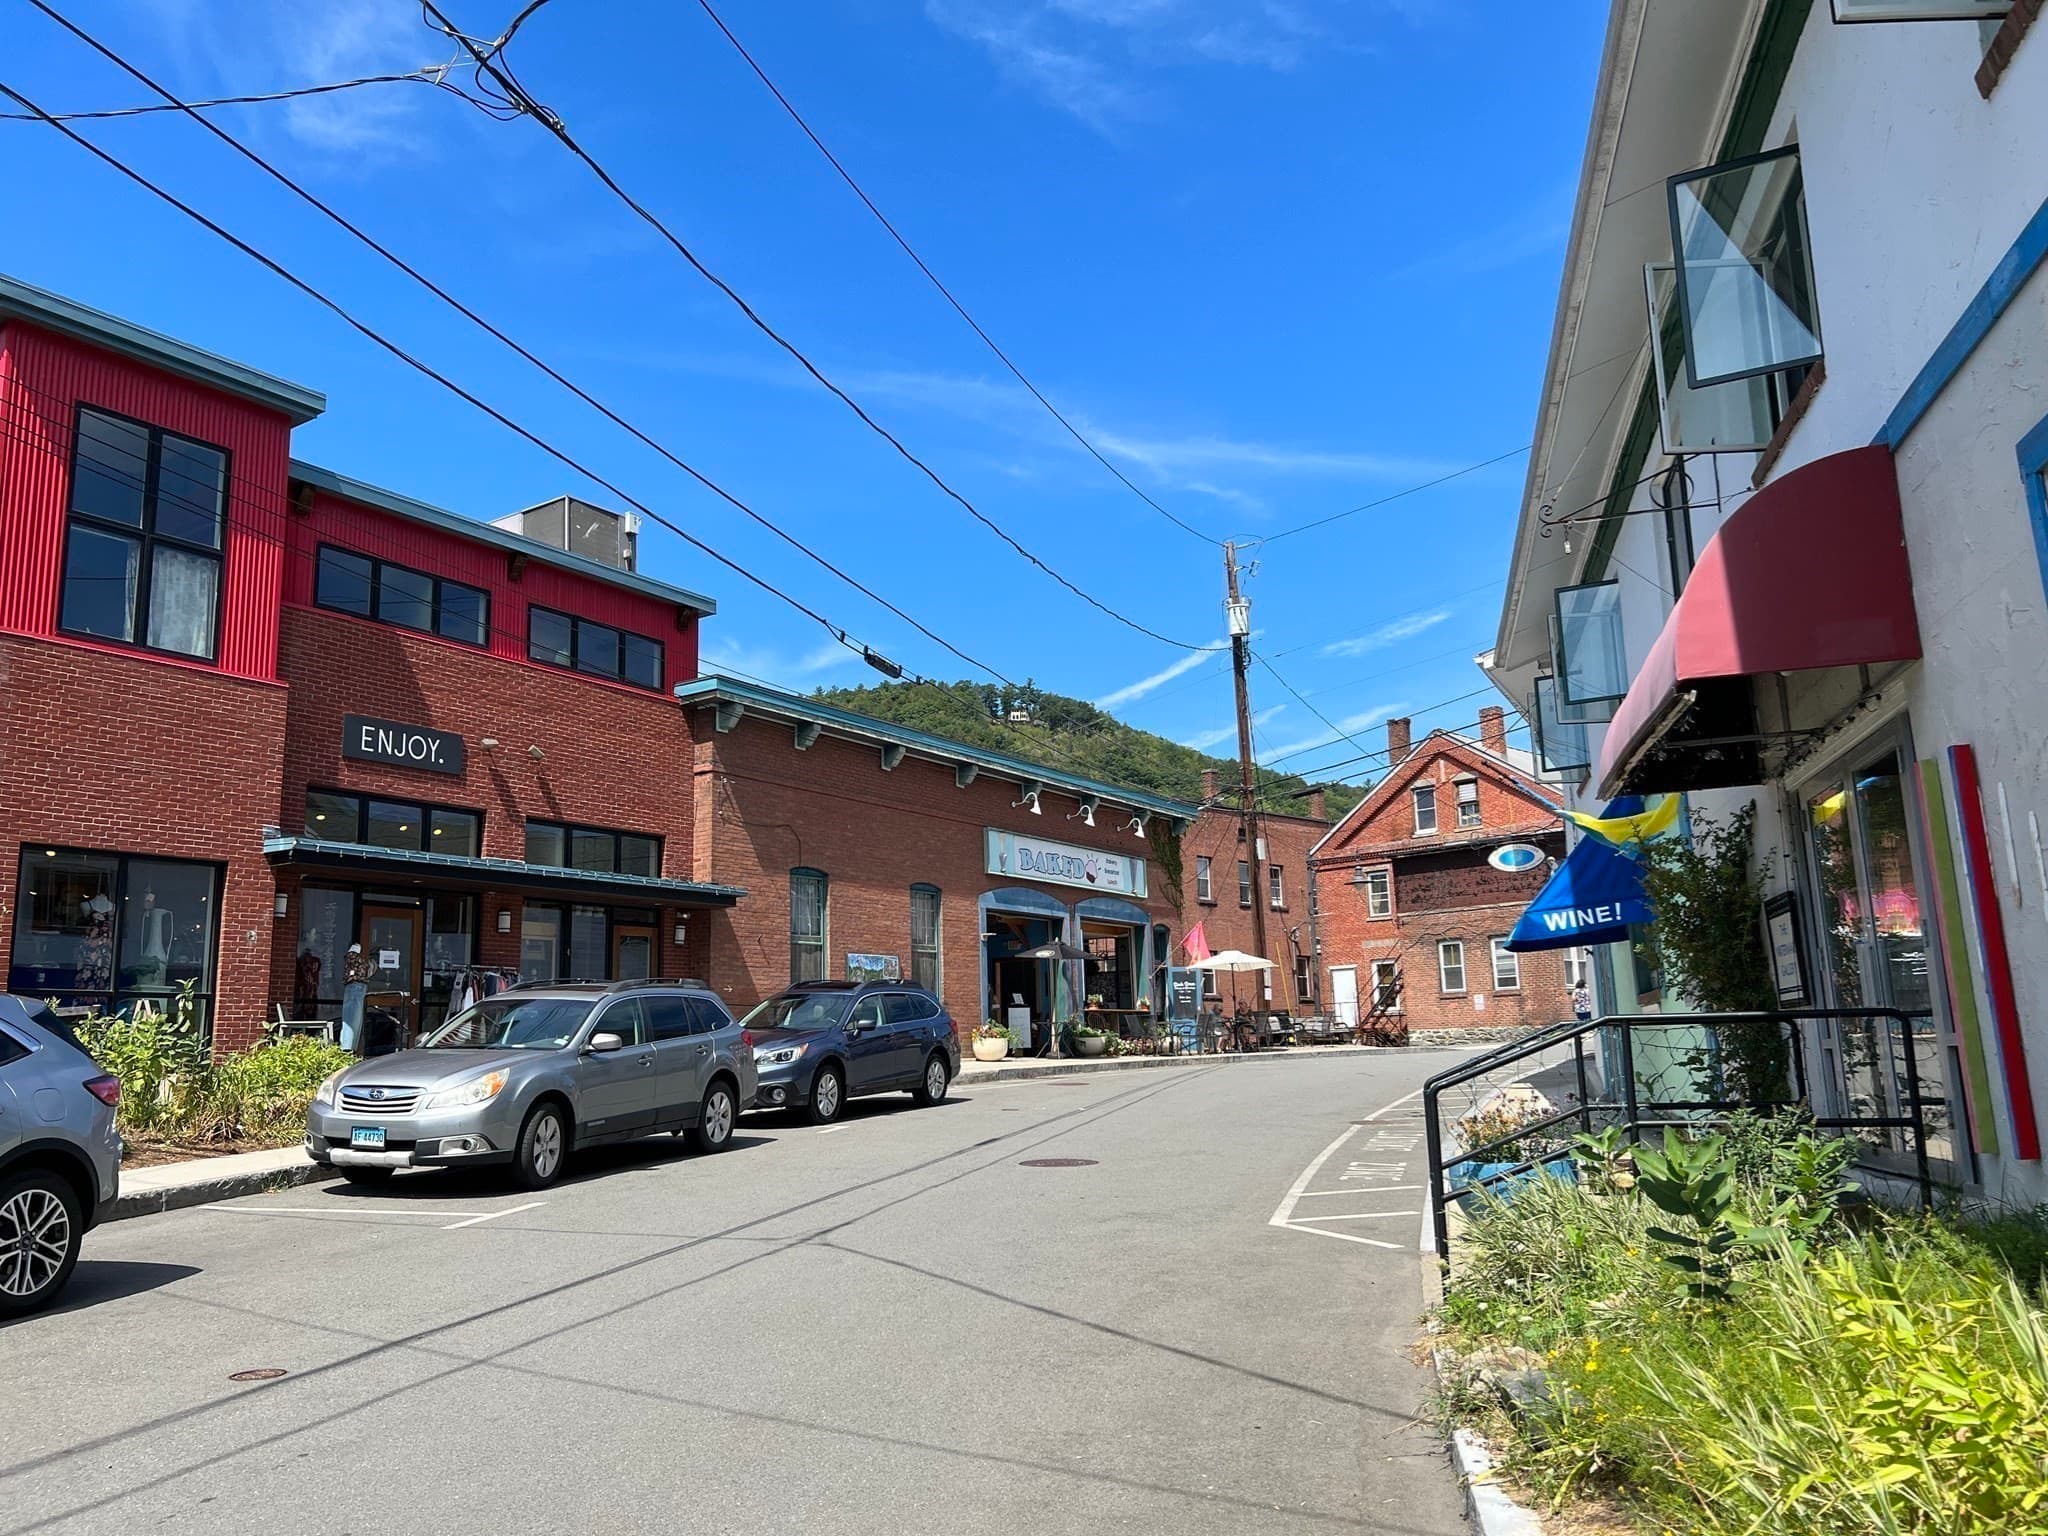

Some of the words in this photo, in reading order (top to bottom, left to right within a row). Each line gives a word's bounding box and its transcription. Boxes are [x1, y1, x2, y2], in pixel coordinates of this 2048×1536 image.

[361, 725, 444, 764] ENJOY.
[1018, 847, 1085, 879] BAKED
[1543, 902, 1622, 932] WINE!
